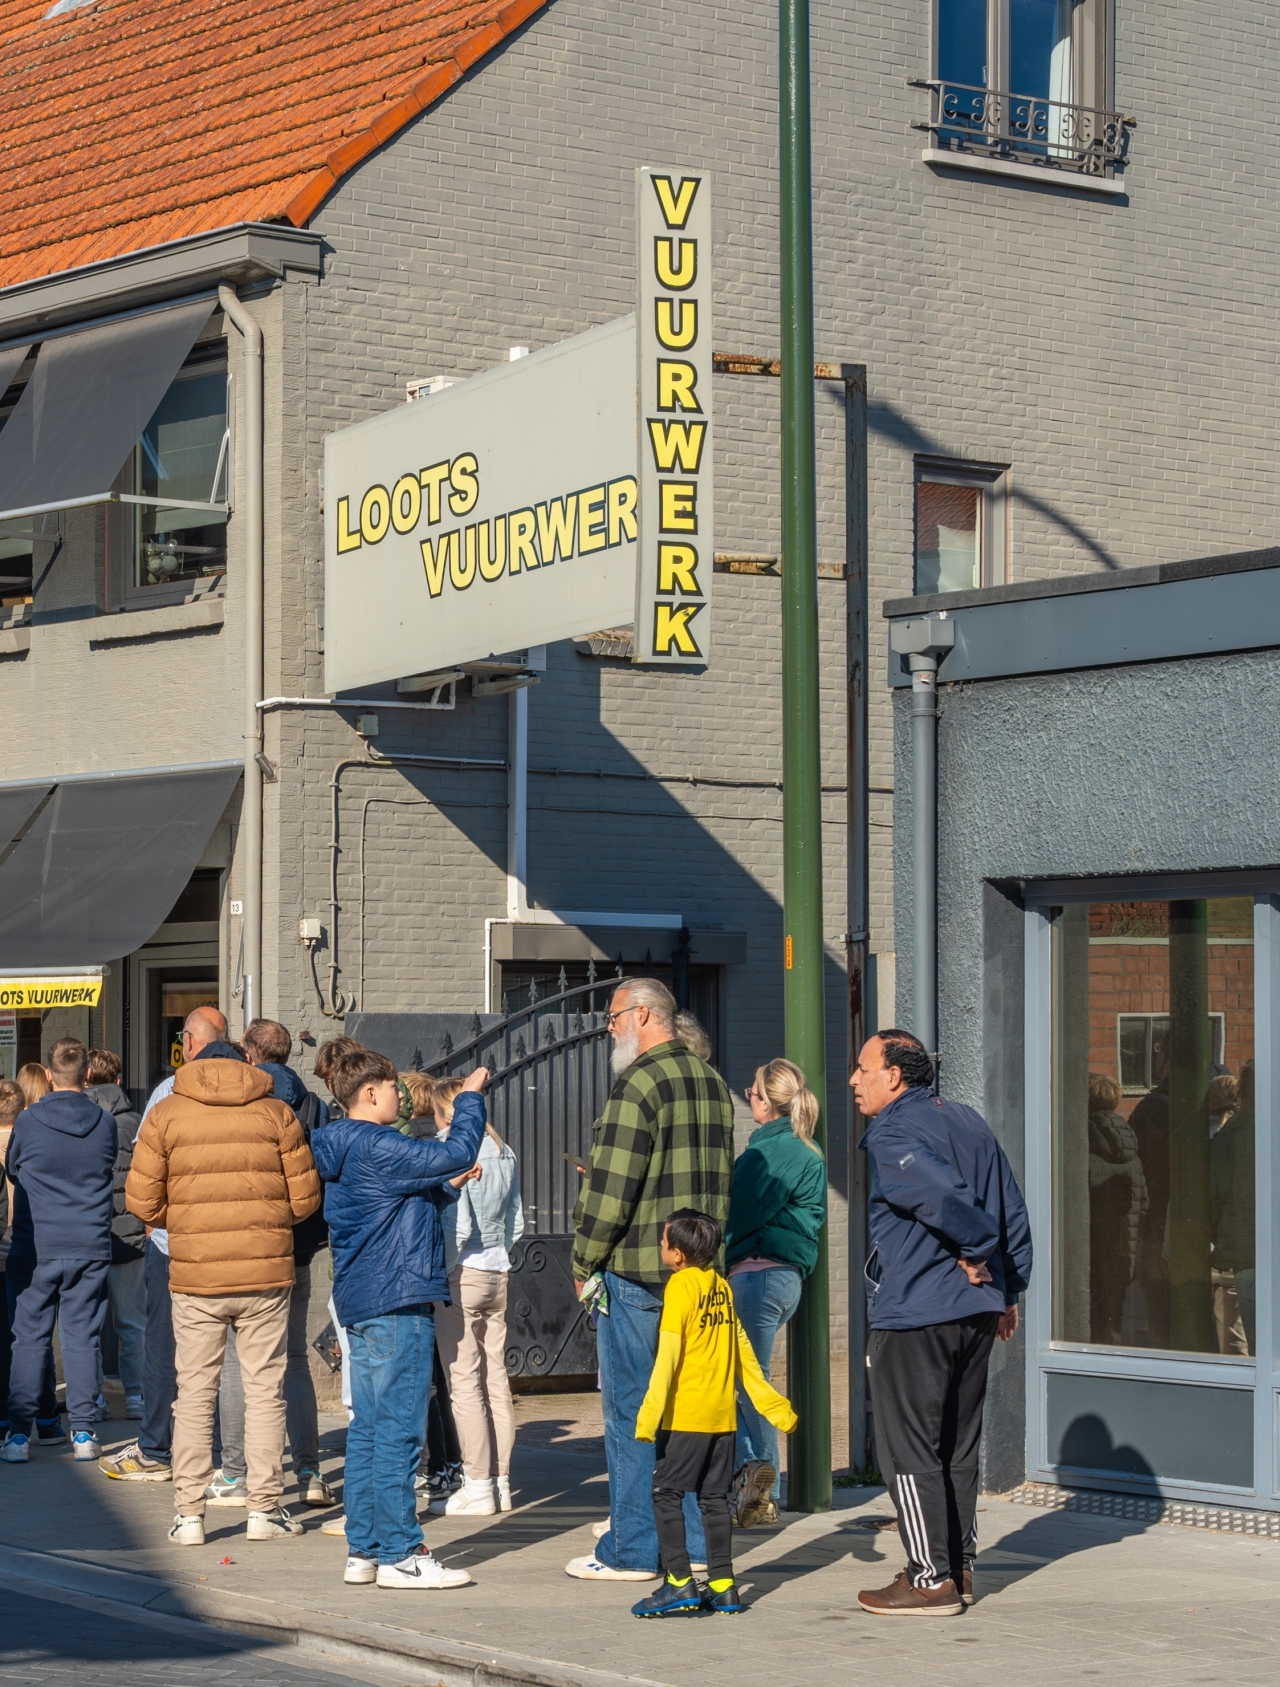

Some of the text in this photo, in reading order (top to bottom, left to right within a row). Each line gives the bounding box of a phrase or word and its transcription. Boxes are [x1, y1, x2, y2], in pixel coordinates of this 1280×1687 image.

[646, 174, 708, 658] VUURWERK
[336, 451, 479, 556] LOOTS
[419, 474, 638, 599] VUURWER
[232, 903, 240, 913] 13
[27, 987, 97, 1005] VUURWERK
